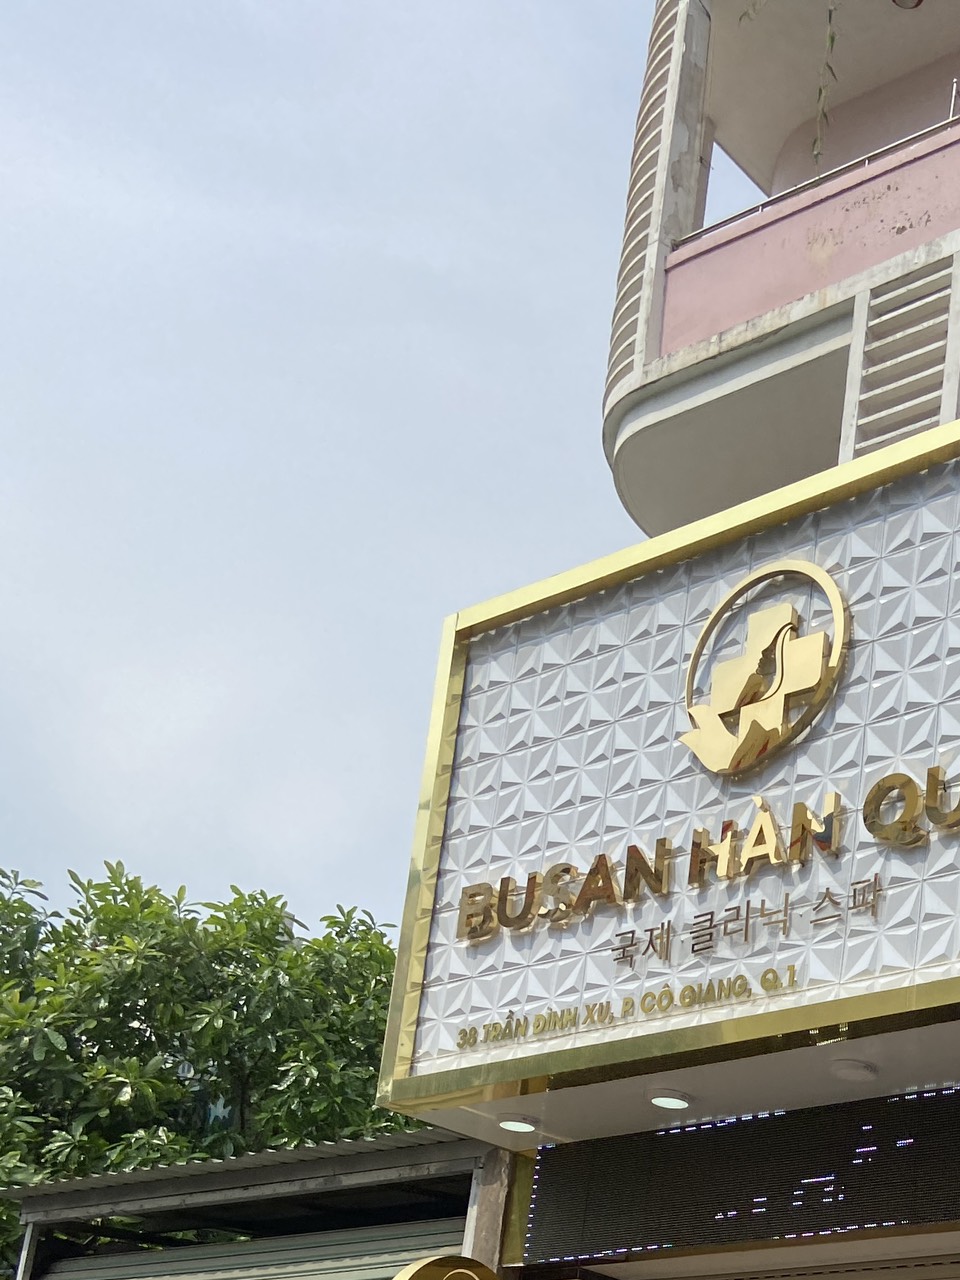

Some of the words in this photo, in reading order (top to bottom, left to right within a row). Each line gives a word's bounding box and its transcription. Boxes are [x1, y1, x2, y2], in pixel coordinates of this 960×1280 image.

[456, 837, 673, 940] BUSAN
[689, 793, 842, 886] HÀN
[611, 919, 671, 969] 국제
[690, 893, 790, 954] 클리닉
[810, 873, 881, 924] 스파
[456, 1026, 478, 1049] 38
[480, 1009, 528, 1044] TRẦN
[532, 1007, 578, 1035] ĐÌNH
[640, 983, 675, 1014] CÔ
